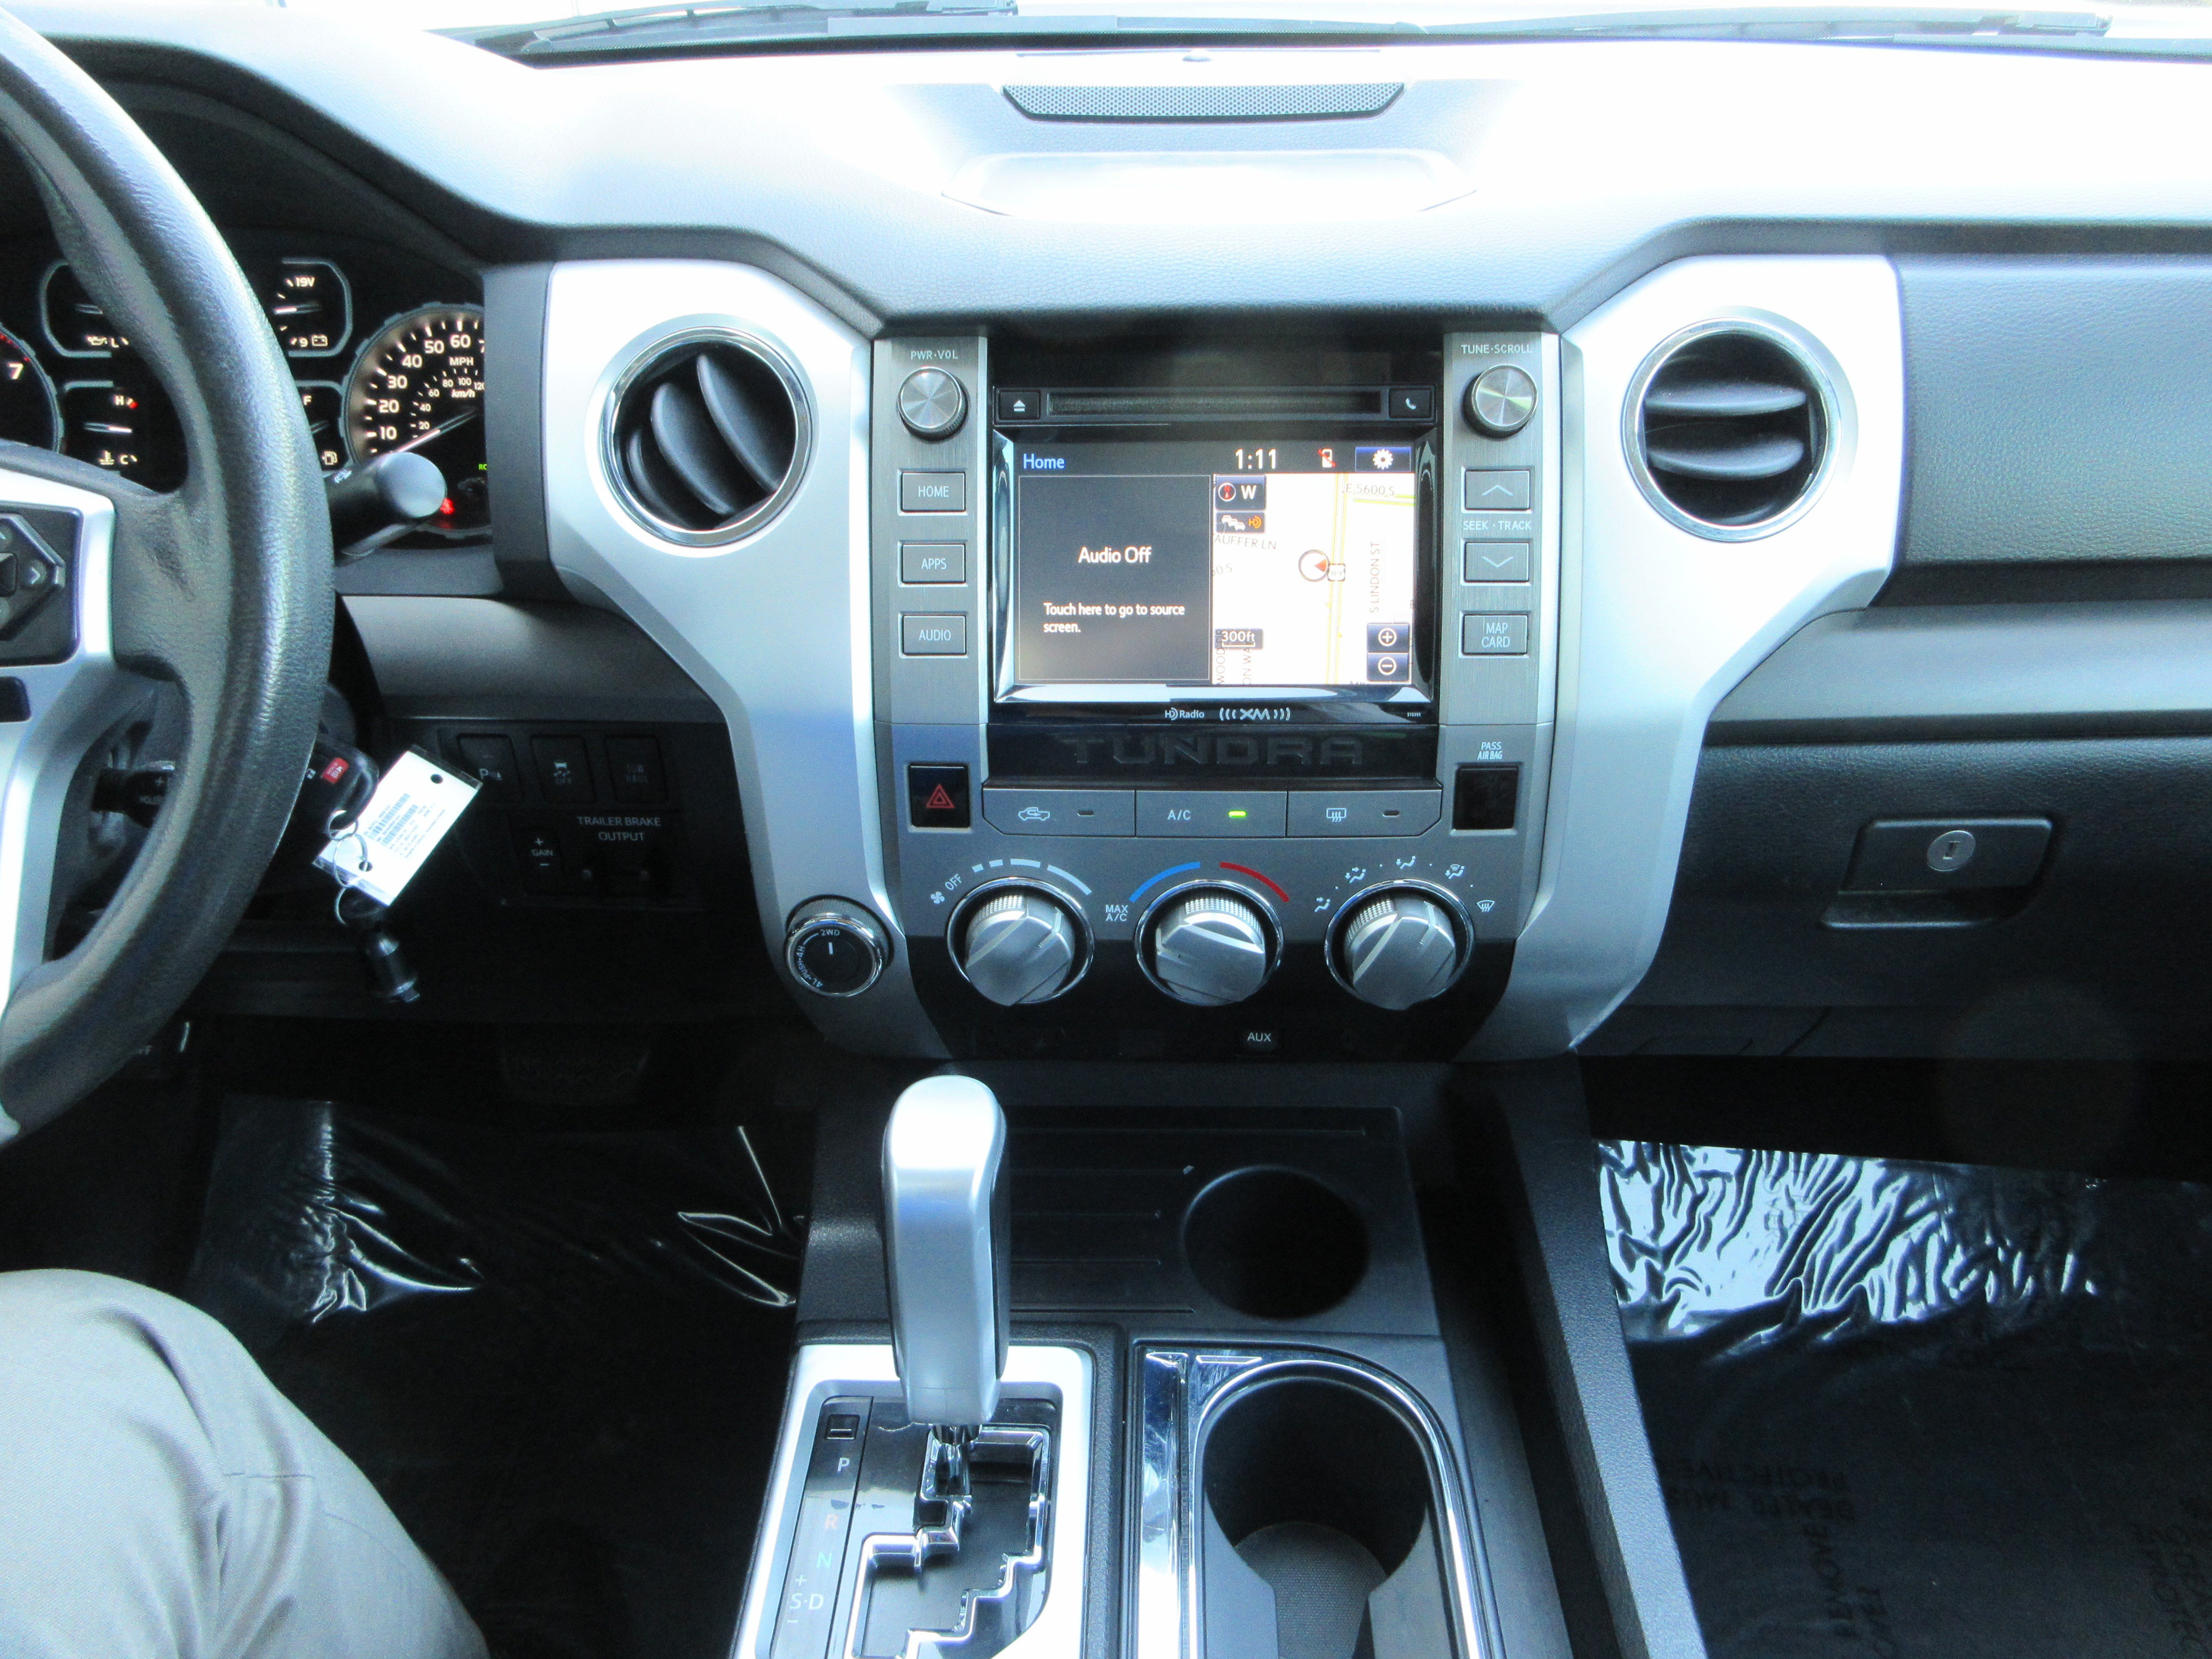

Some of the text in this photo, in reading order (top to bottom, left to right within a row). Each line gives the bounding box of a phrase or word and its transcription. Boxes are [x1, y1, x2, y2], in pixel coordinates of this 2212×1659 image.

[296, 277, 314, 287] 19V
[111, 338, 119, 348] L
[300, 338, 308, 347] 9
[424, 341, 445, 354] 50
[451, 335, 470, 348] 60
[402, 355, 422, 368] 40
[449, 357, 473, 366] MPH
[7, 362, 24, 380] 7
[388, 375, 407, 389] 30
[442, 379, 453, 387] 80
[458, 377, 472, 386] 100
[428, 389, 439, 398] 60
[451, 387, 475, 399] km/h
[114, 396, 123, 406] H
[304, 396, 311, 406] F
[379, 400, 399, 413] 20
[420, 404, 431, 412] 40
[419, 421, 430, 430] 20
[380, 427, 396, 439] 10
[120, 454, 129, 465] C
[1023, 454, 1065, 469] Home
[1235, 448, 1277, 469] 1:11
[918, 486, 949, 498] HOME
[1241, 485, 1255, 500] W
[1346, 483, 1394, 496] E 5600 S
[1464, 521, 1532, 530] SEEK TRACK
[1213, 533, 1276, 550] AUFFER LN
[1371, 541, 1380, 555] ST
[1079, 547, 1151, 564] Audio Off
[921, 558, 946, 570] APPS
[1370, 559, 1380, 603] LINDON
[1043, 602, 1185, 619] Touch here to go to source
[1043, 622, 1081, 633] screen.
[1487, 623, 1508, 634] MAP
[919, 629, 951, 641] AUDIO
[1222, 631, 1255, 642] 300ft
[1481, 636, 1510, 648] CARD
[1179, 709, 1204, 719] Radio
[1060, 736, 1362, 764] TUNDRA
[1481, 742, 1501, 750] PASS
[1478, 751, 1502, 760] AIR BAG
[577, 816, 661, 827] TRAILER BRAKE
[1167, 810, 1190, 821] A/C
[598, 832, 644, 841] OUTPUT
[945, 874, 963, 891] OFF
[1105, 905, 1129, 914] MAX
[1106, 914, 1126, 922] A/C
[1248, 1033, 1271, 1043] AUX
[837, 1458, 850, 1471] P
[826, 1515, 838, 1528] R
[818, 1553, 832, 1567] N
